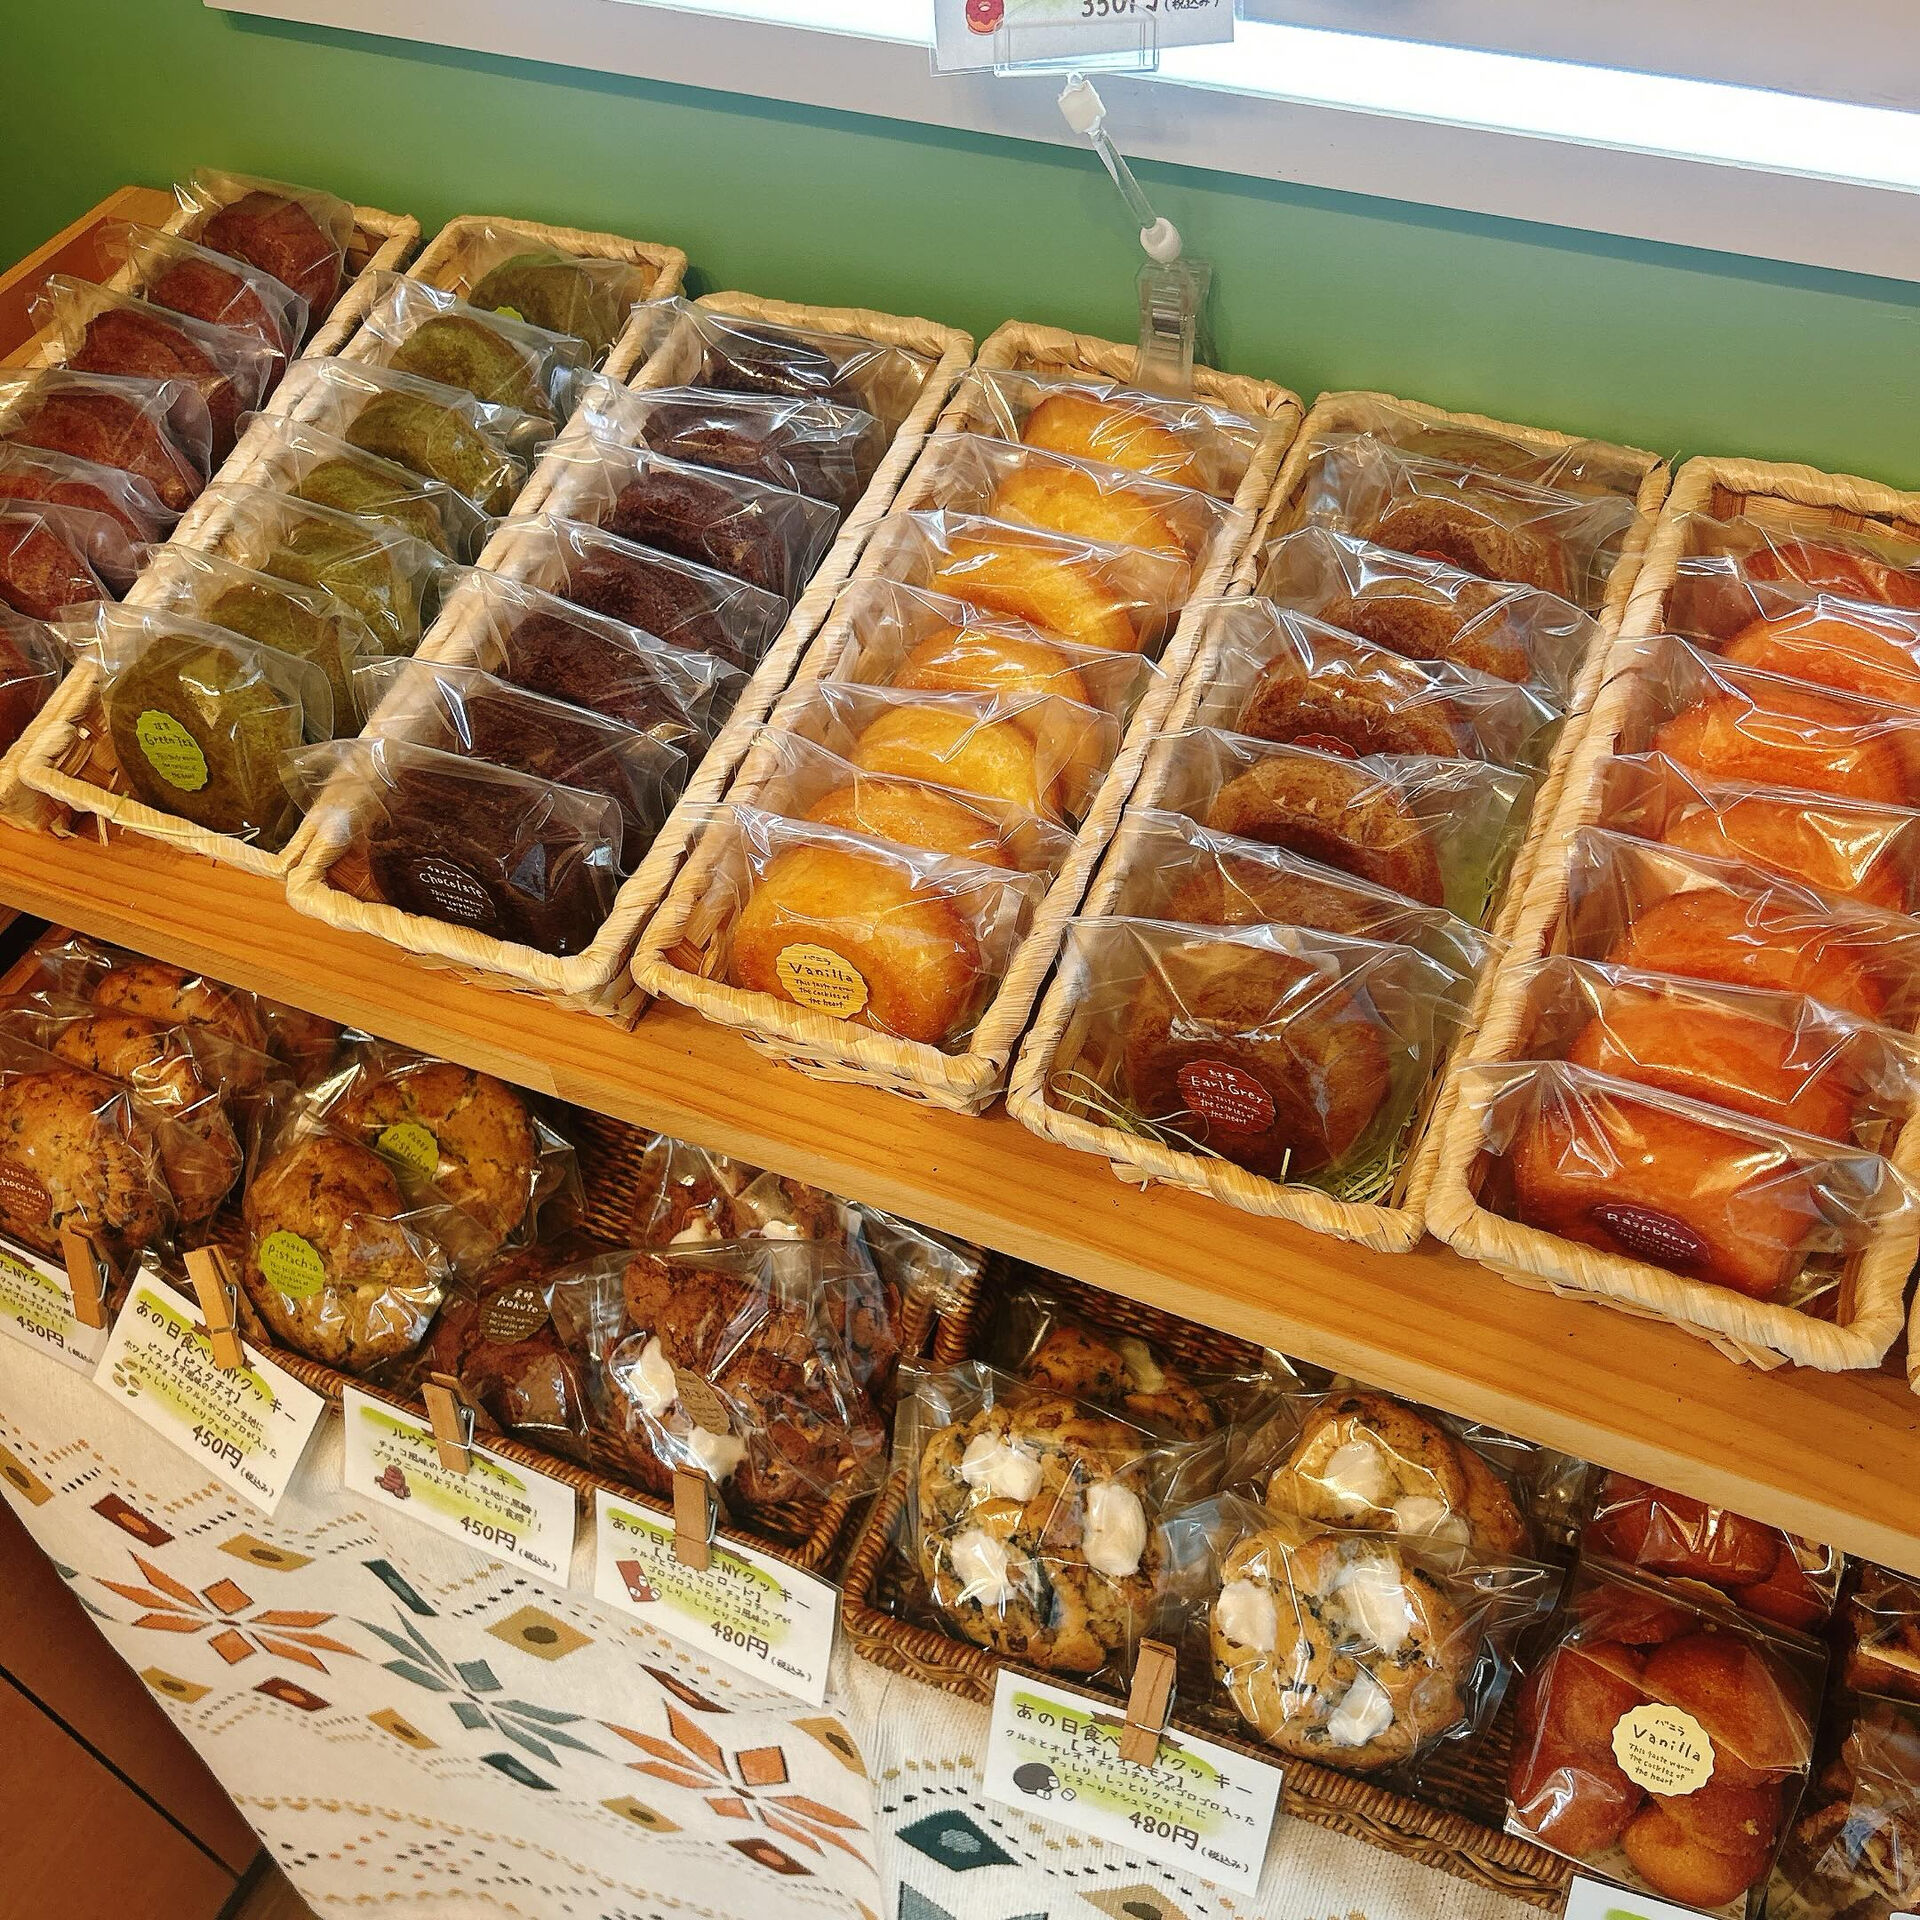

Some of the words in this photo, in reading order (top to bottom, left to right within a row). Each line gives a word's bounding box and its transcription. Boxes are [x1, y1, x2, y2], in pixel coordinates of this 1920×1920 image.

[419, 872, 483, 899] Chocolate
[789, 962, 854, 984] Vanilla
[1190, 1075, 1225, 1091] Earl
[1227, 1084, 1264, 1104] Grey
[0, 1177, 26, 1191] hoco
[1606, 1212, 1698, 1249] Raspberry
[267, 1244, 319, 1272] Pistachio
[17, 1315, 64, 1349] 450円
[148, 1341, 264, 1433] ピスタチオ風味のクッキー生地に
[173, 1347, 242, 1405] 【ピスタチオ】
[192, 1424, 243, 1470] 450円
[241, 1467, 275, 1498] (税込み)
[391, 1427, 528, 1493] ルヴァッキー
[460, 1516, 517, 1552] 450円
[518, 1548, 559, 1573] (税込み)
[611, 1516, 810, 1609] あの日NYクッキー
[648, 1565, 771, 1628] ゴロゴロ入ったチョコ風味の
[654, 1547, 761, 1604] 【ローロード】
[710, 1621, 769, 1661] 480円
[770, 1656, 813, 1683] (税込み)
[1016, 1703, 1253, 1796] あの日食べYクッキー
[1633, 1724, 1701, 1762] Vanilla
[1655, 1719, 1685, 1737] バニラ
[1005, 1728, 1256, 1827] クルミとオレオ、チョコチップがゴロゴロ入った
[1628, 1742, 1645, 1755] This
[1647, 1750, 1668, 1764] taste
[1669, 1759, 1695, 1775] warms
[1628, 1753, 1642, 1764] the
[1676, 1773, 1685, 1781] of
[1634, 1766, 1648, 1776] the
[1650, 1772, 1674, 1786] heart
[1047, 1755, 1207, 1820] ずっしり、しっとりクッキーに
[1063, 1772, 1185, 1824] とろーりマシュマロ！！
[1128, 1811, 1199, 1851] 480円
[1201, 1847, 1249, 1873] (税込み)
